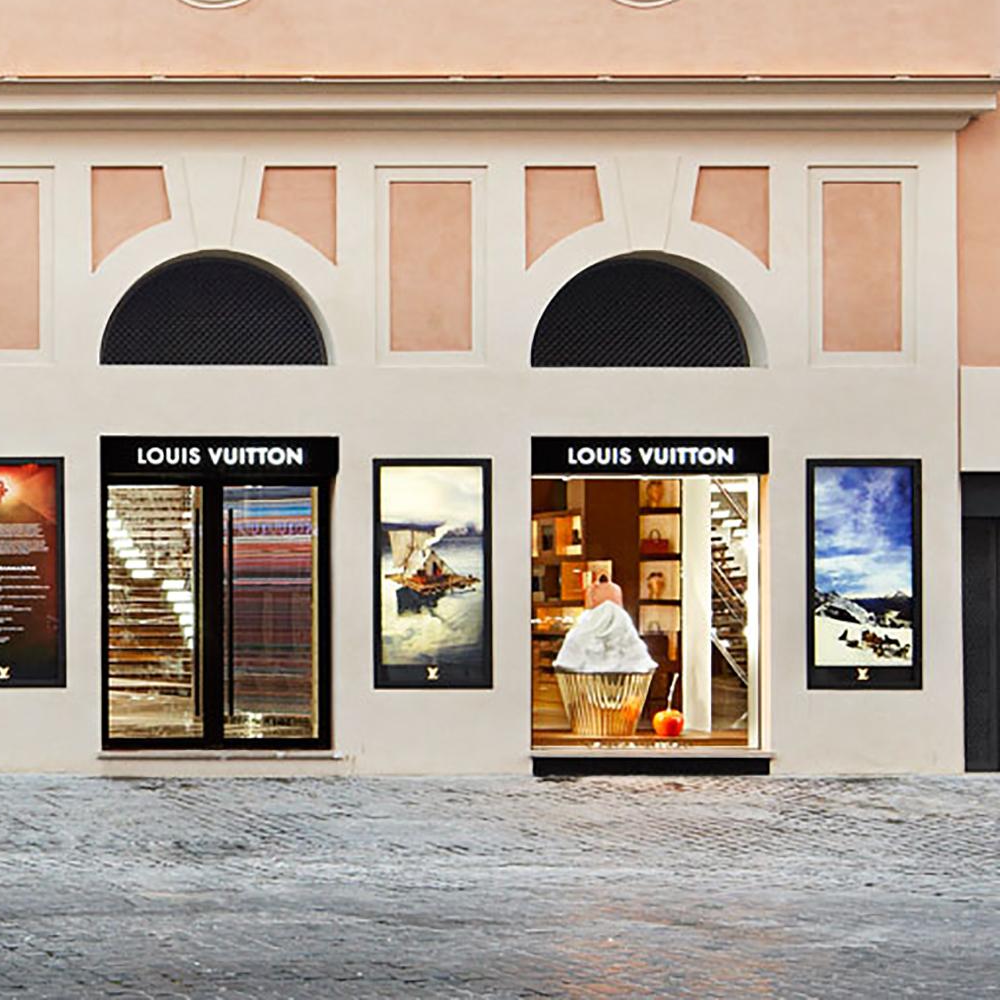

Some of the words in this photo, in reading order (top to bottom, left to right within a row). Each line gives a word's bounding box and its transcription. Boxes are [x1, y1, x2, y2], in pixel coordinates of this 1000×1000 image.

[137, 446, 202, 466] LOUIS
[207, 446, 304, 466] VUITTON
[567, 446, 632, 466] LOUIS
[638, 446, 734, 466] VUITTON
